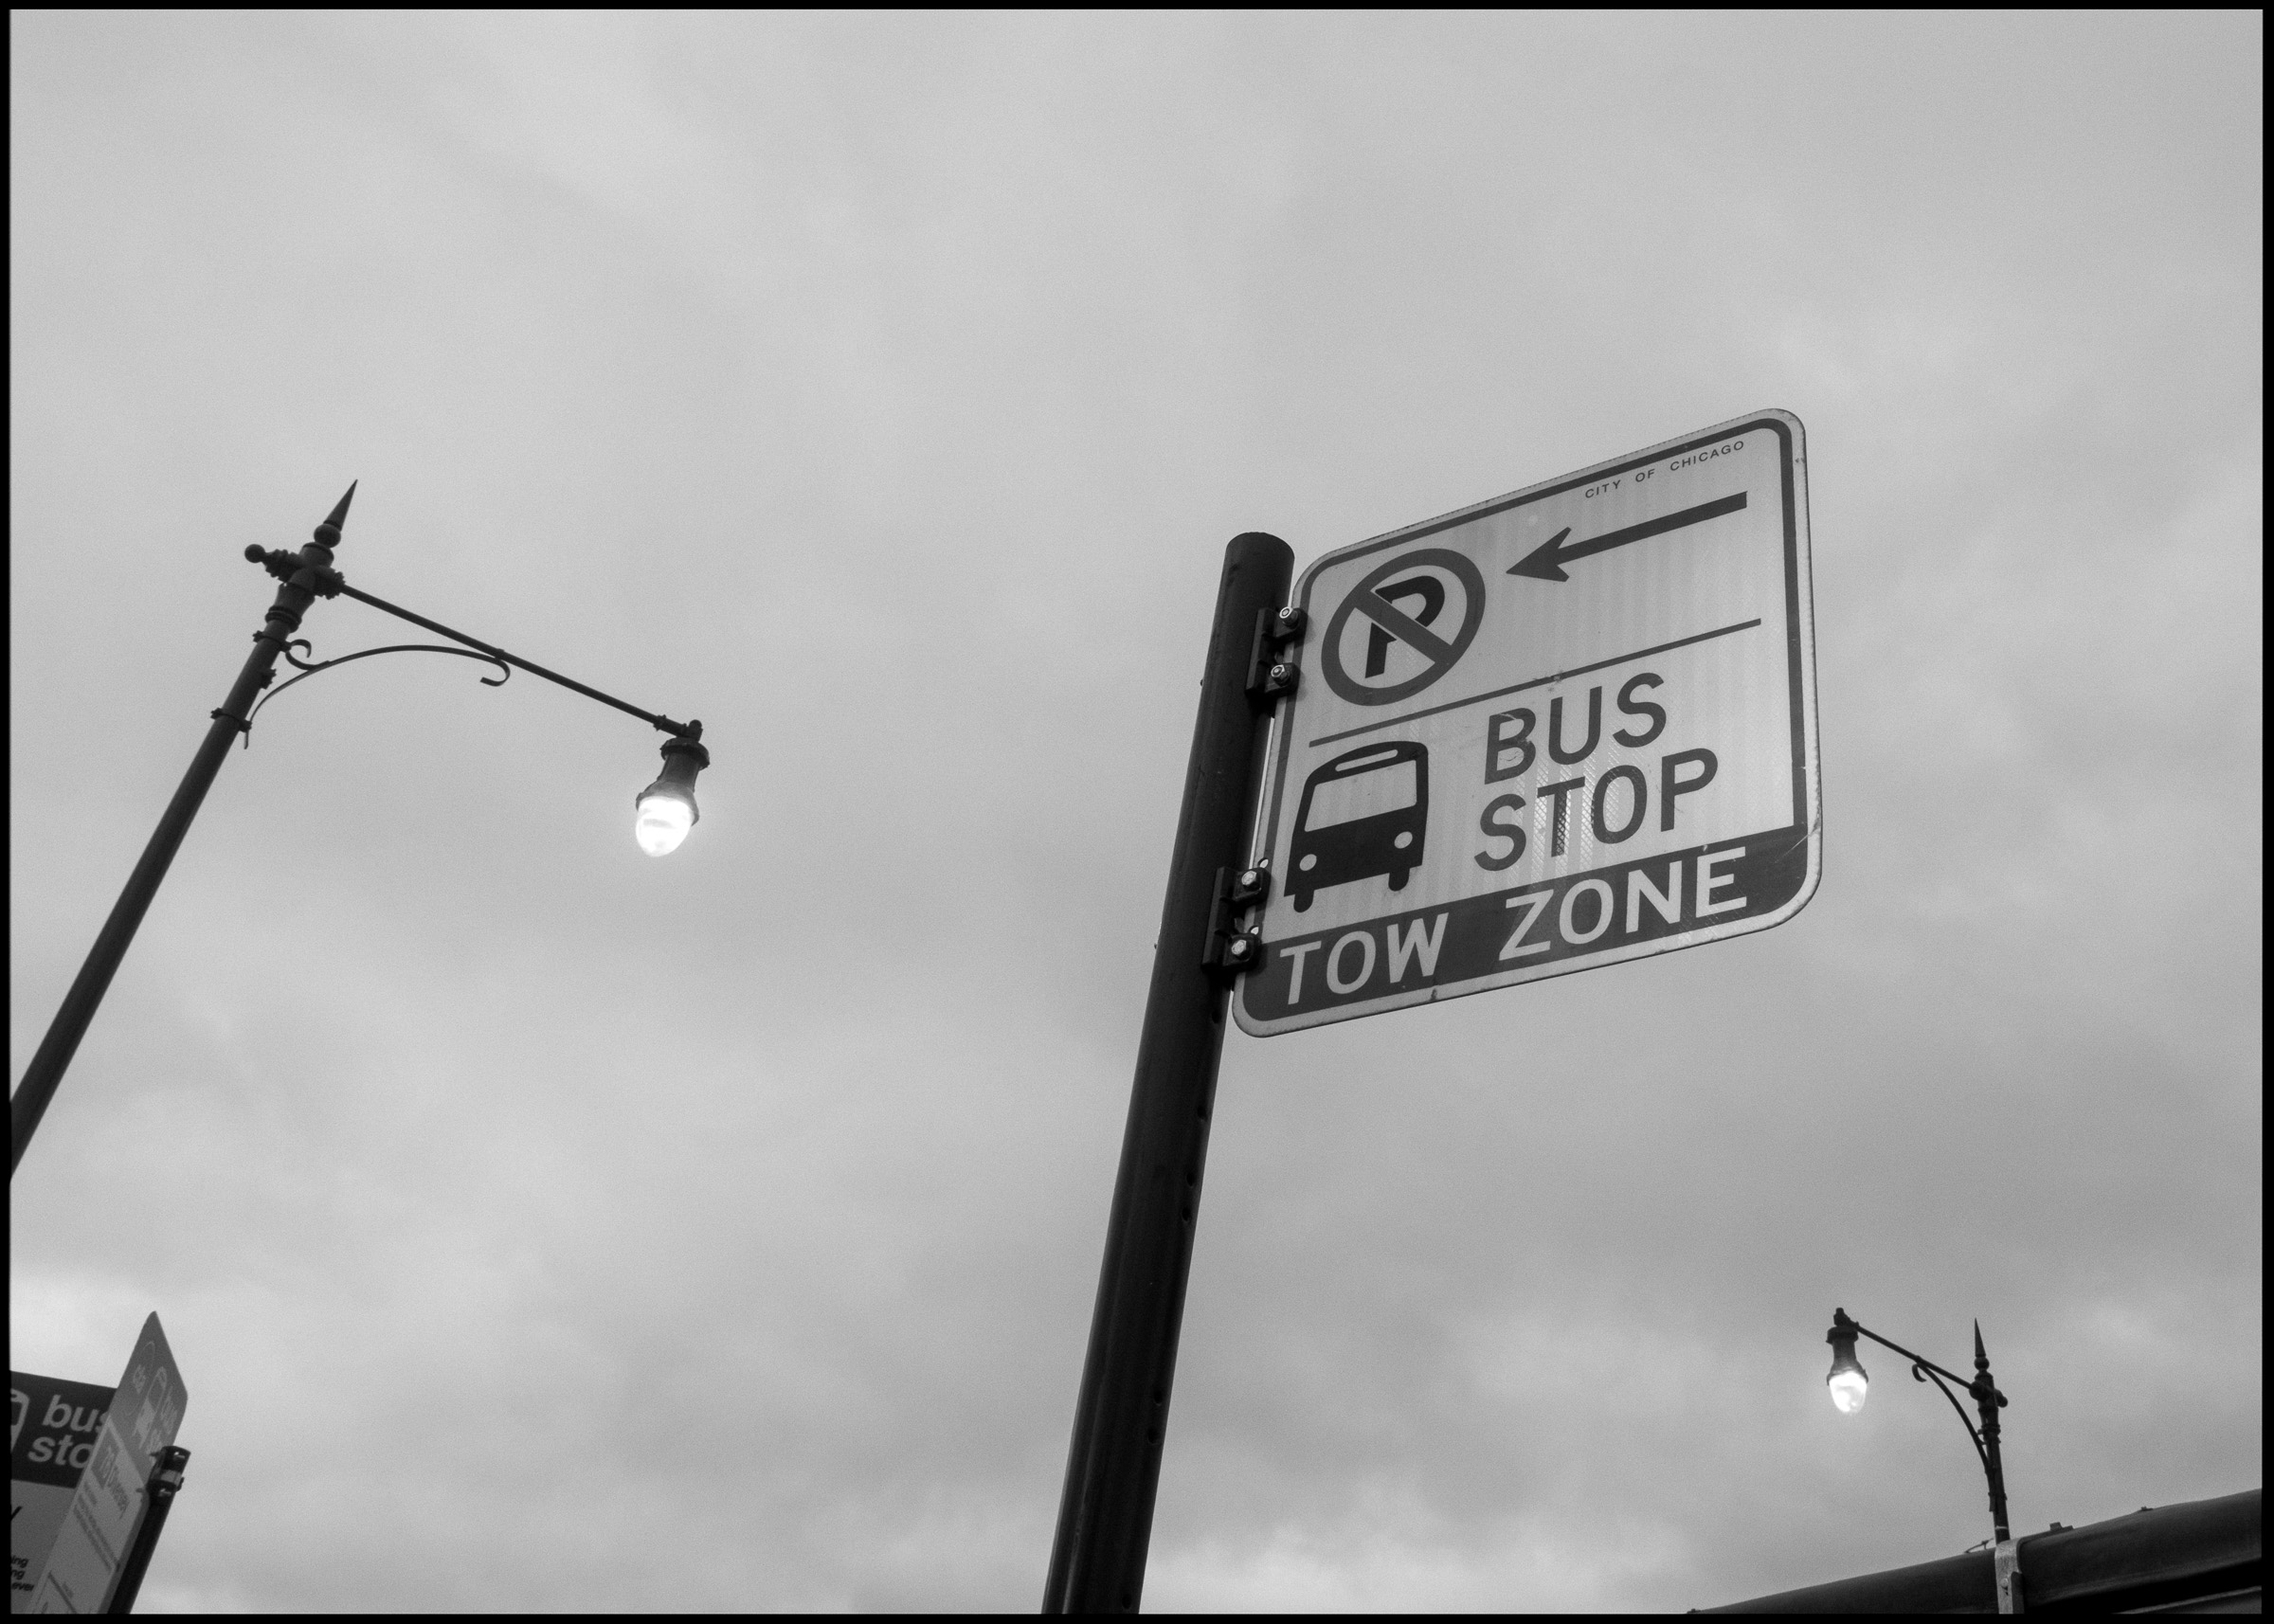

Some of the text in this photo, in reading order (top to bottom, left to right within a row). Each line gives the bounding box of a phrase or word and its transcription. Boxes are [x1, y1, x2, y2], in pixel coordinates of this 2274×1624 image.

[1584, 441, 1744, 498] CITY OF CHICAGO
[1484, 673, 1667, 785] BUS
[1473, 748, 1718, 872] STOP
[1278, 847, 1747, 1005] TOW ZONE
[27, 1434, 96, 1469] sto
